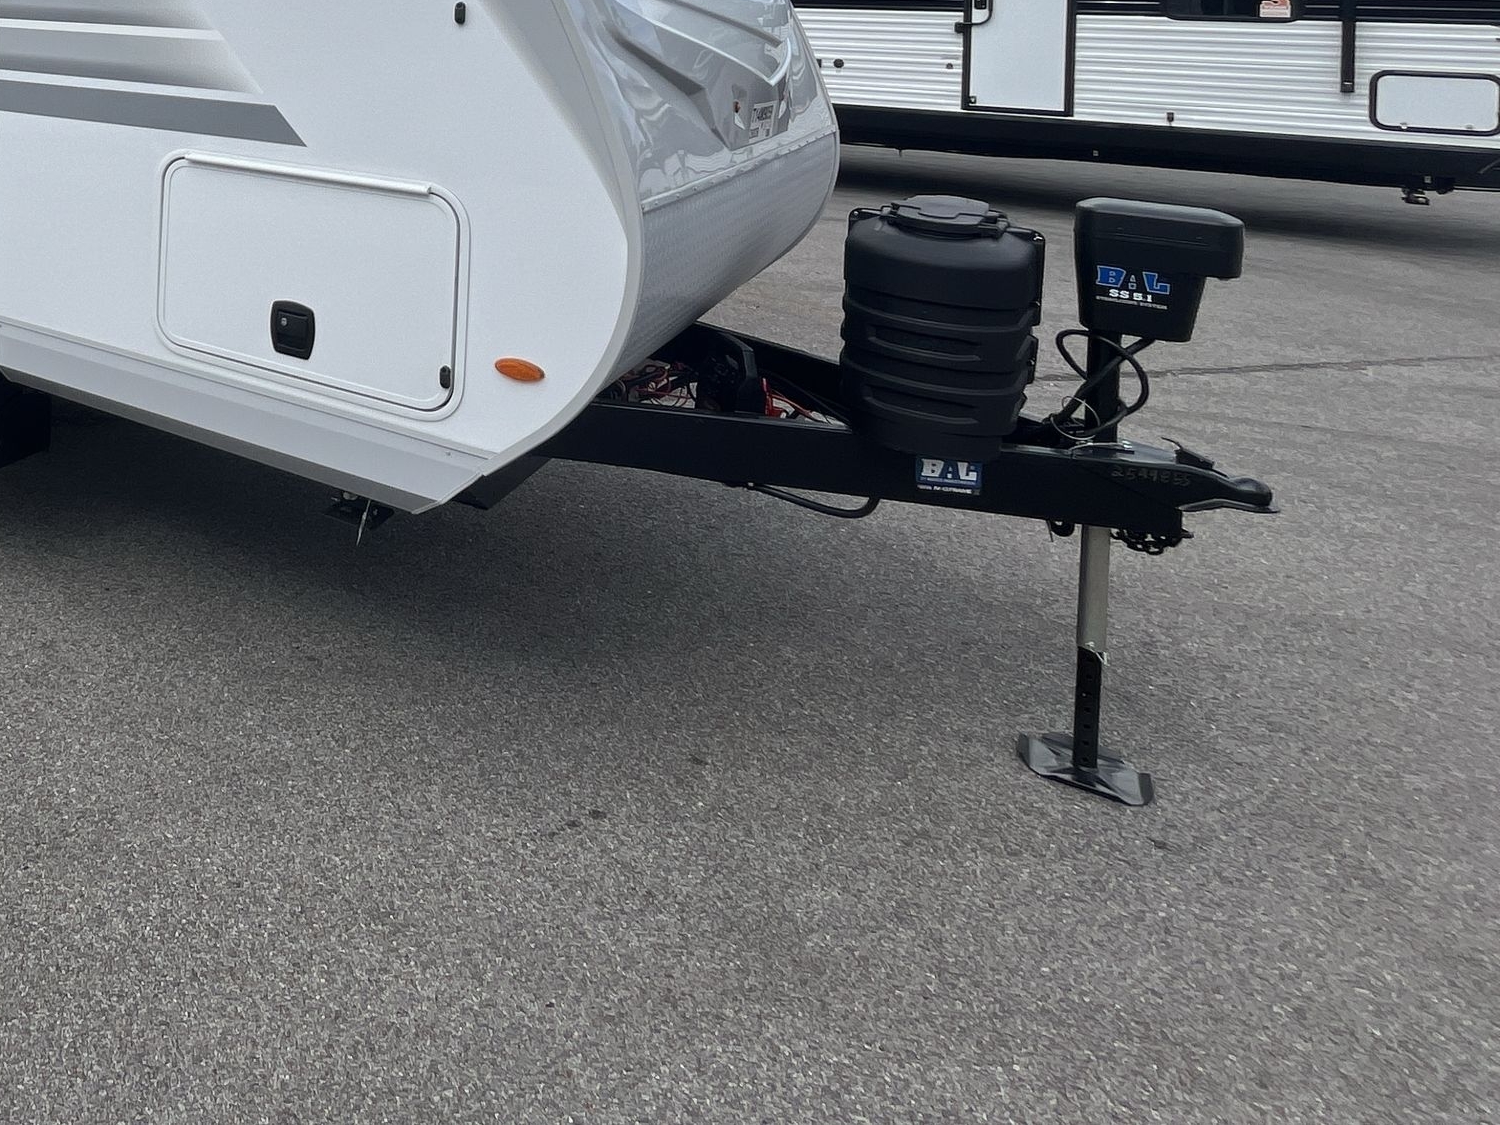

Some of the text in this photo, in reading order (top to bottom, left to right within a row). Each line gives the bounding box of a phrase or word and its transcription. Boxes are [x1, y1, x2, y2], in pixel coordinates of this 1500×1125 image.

[1096, 265, 1171, 295] BAL
[1108, 288, 1130, 299] SS
[920, 458, 977, 481] BAL
